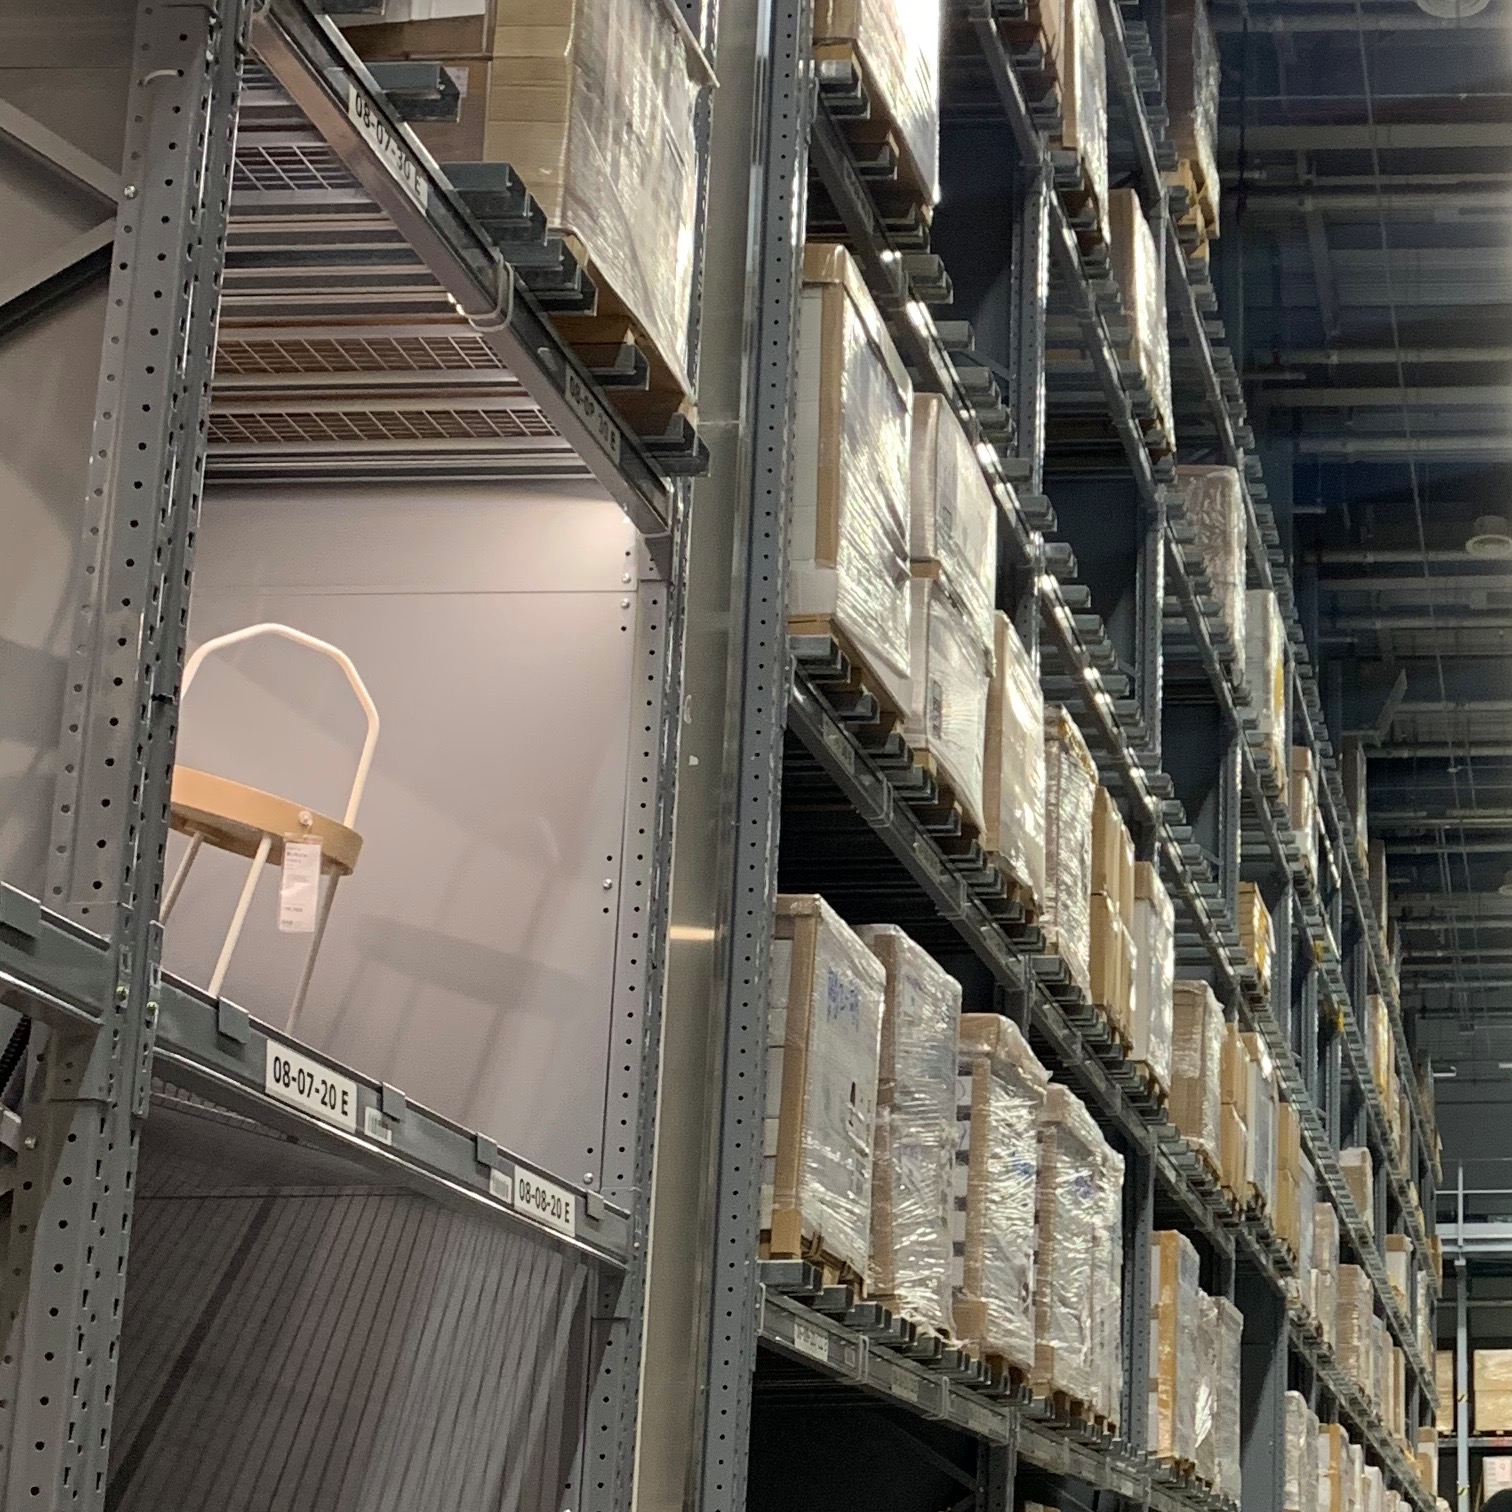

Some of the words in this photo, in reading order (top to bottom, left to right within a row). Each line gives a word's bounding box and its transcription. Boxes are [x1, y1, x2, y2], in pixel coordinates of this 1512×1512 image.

[273, 1055, 337, 1110] 08-07-20
[340, 1089, 349, 1116] E
[518, 1178, 562, 1220] 08-08-20
[563, 1201, 570, 1224] E
